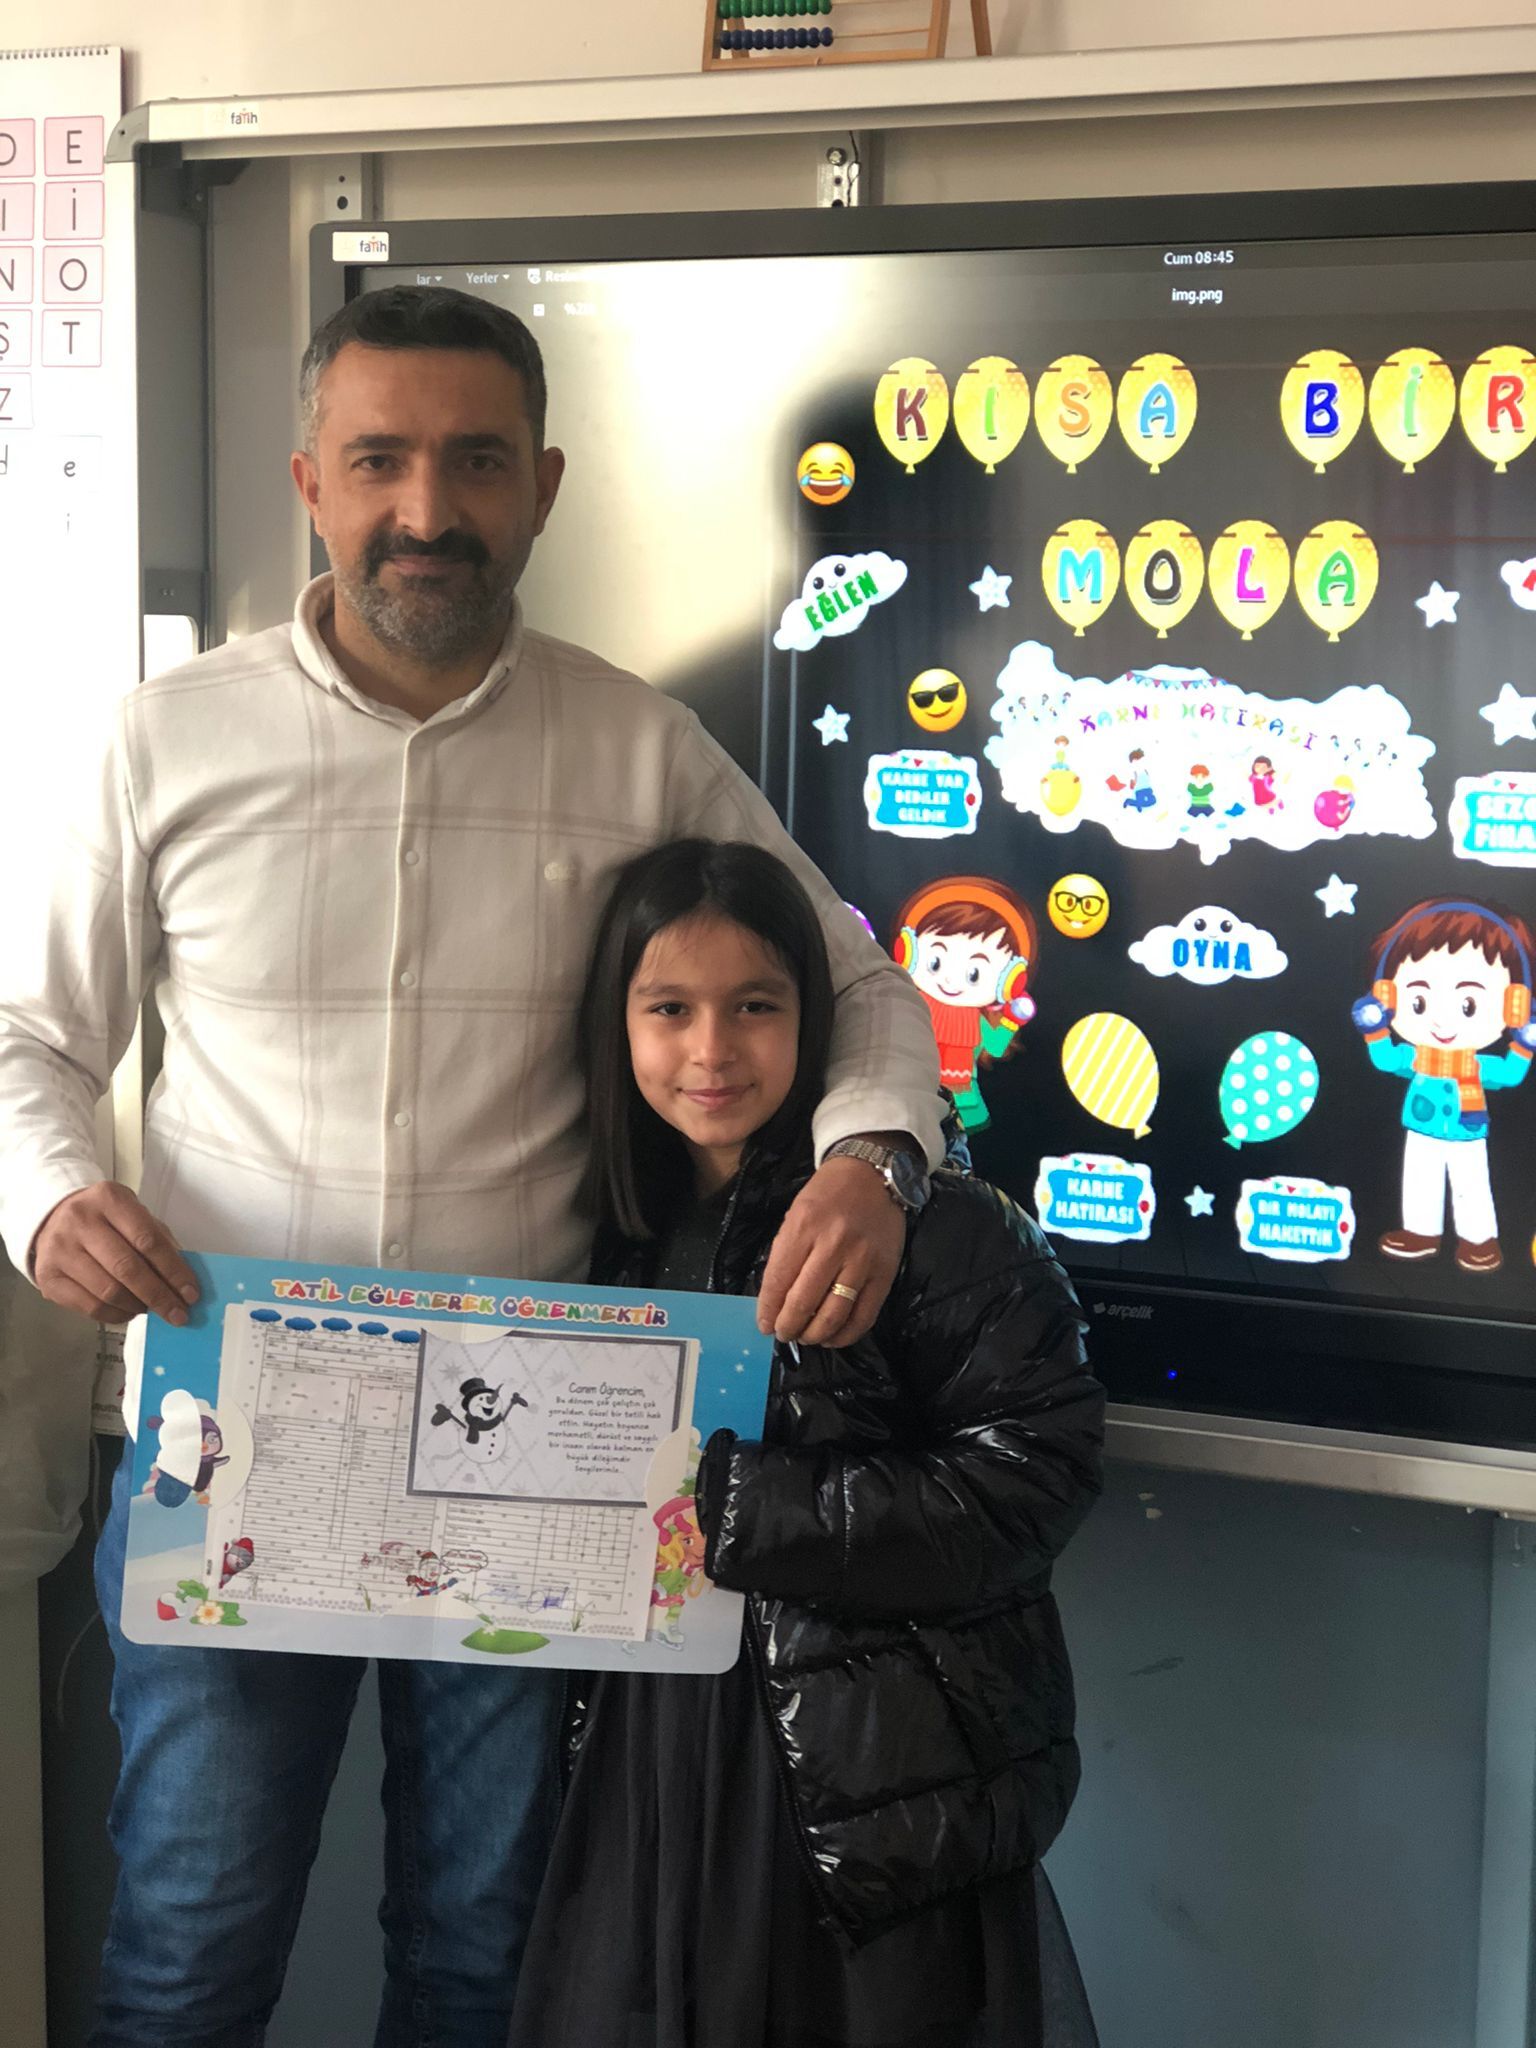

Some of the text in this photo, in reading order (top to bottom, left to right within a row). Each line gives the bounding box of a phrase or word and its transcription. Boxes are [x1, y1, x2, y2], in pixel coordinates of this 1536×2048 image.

[66, 130, 83, 164] E
[1163, 250, 1235, 266] Cum 08:45
[59, 258, 88, 292] O
[465, 272, 499, 285] Yerler
[1171, 288, 1224, 305] img.png
[62, 321, 81, 355] T
[63, 460, 77, 478] e
[1057, 548, 1357, 607] MOLA
[1172, 938, 1253, 972] OYNA
[1067, 1177, 1125, 1201] KARNE
[1055, 1200, 1135, 1225] HATIRASI
[273, 1280, 667, 1326] TATİL EĞLENEREK ÖĞRENMEKTİR
[1107, 1303, 1155, 1321] arçelik
